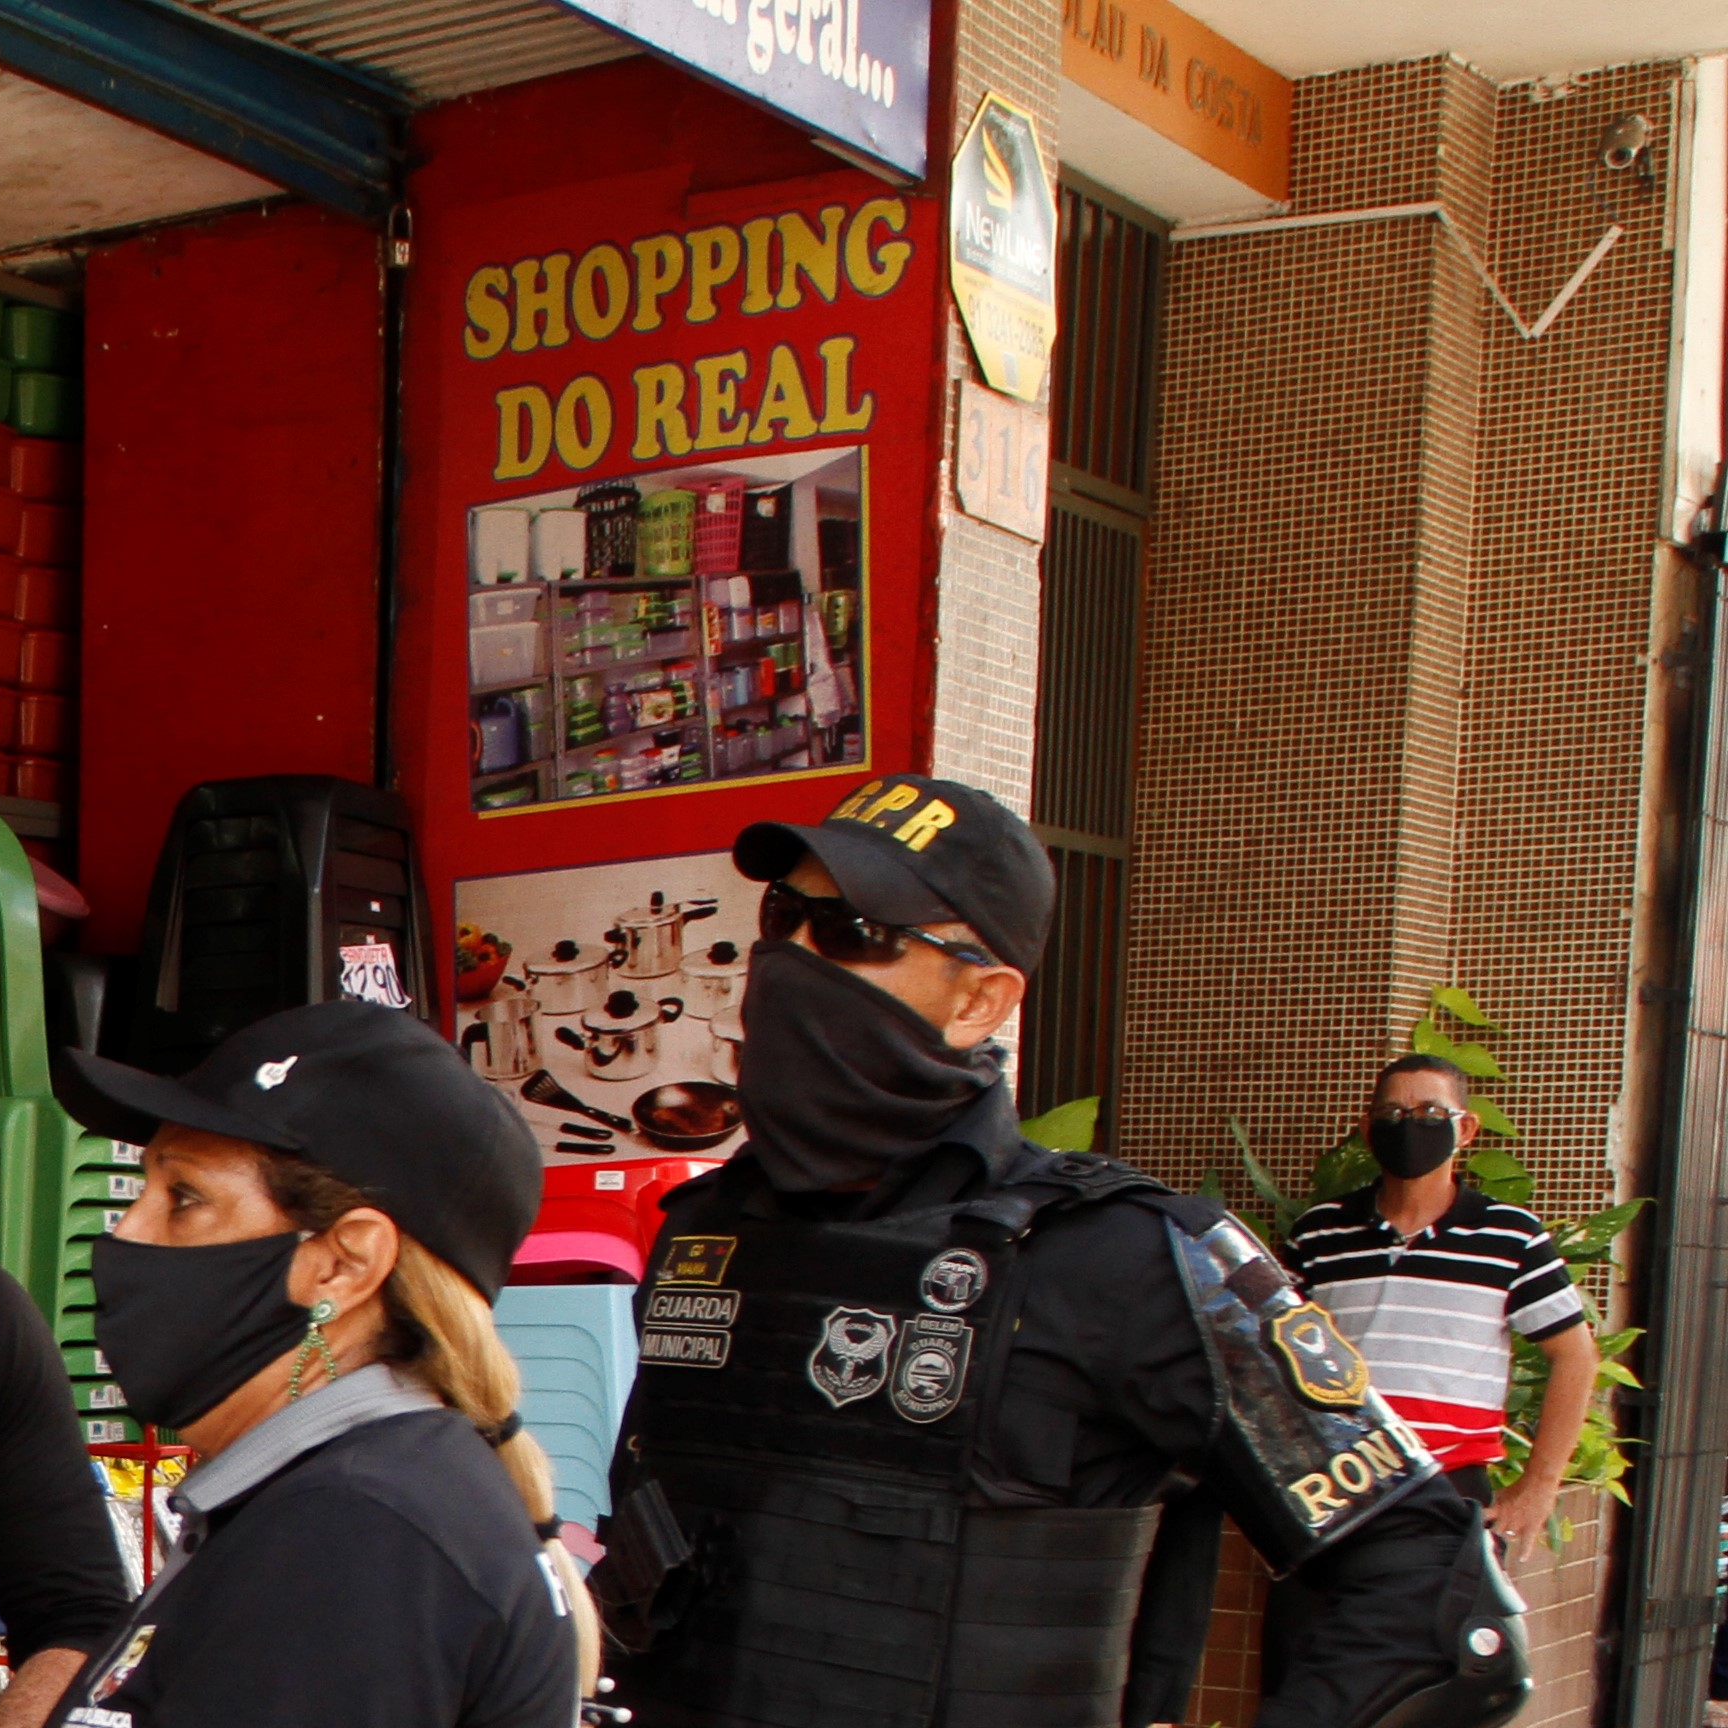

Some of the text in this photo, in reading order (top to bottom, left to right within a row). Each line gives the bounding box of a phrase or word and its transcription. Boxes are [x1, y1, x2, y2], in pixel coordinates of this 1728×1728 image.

[1139, 24, 1170, 94] DA
[1184, 55, 1263, 147] COSTA
[464, 197, 913, 361] SHOPPING
[493, 335, 874, 482] DO REAL
[966, 408, 1042, 513] 316
[643, 1333, 723, 1361] MUNICIPAL
[651, 1296, 733, 1320] GUARDA
[910, 1337, 959, 1356] GUARDA
